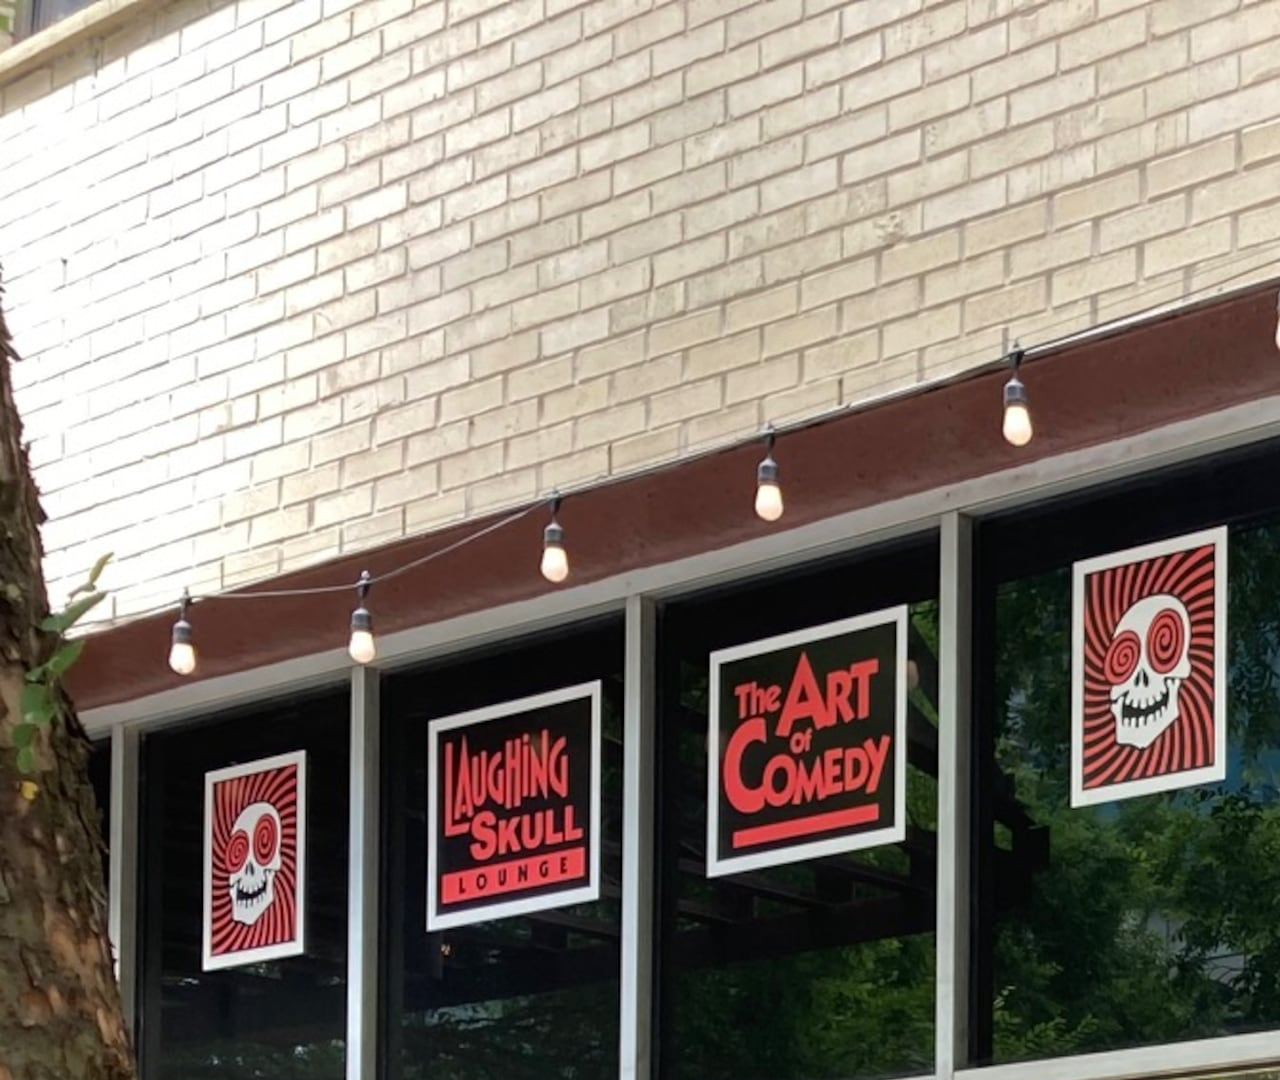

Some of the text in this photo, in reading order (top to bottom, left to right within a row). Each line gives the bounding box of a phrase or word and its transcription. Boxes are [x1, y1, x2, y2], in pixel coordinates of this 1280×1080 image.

[735, 651, 880, 737] The ART
[723, 717, 891, 814] COMEDY
[470, 805, 583, 861] SKULL
[457, 856, 570, 895] LOUNGE
